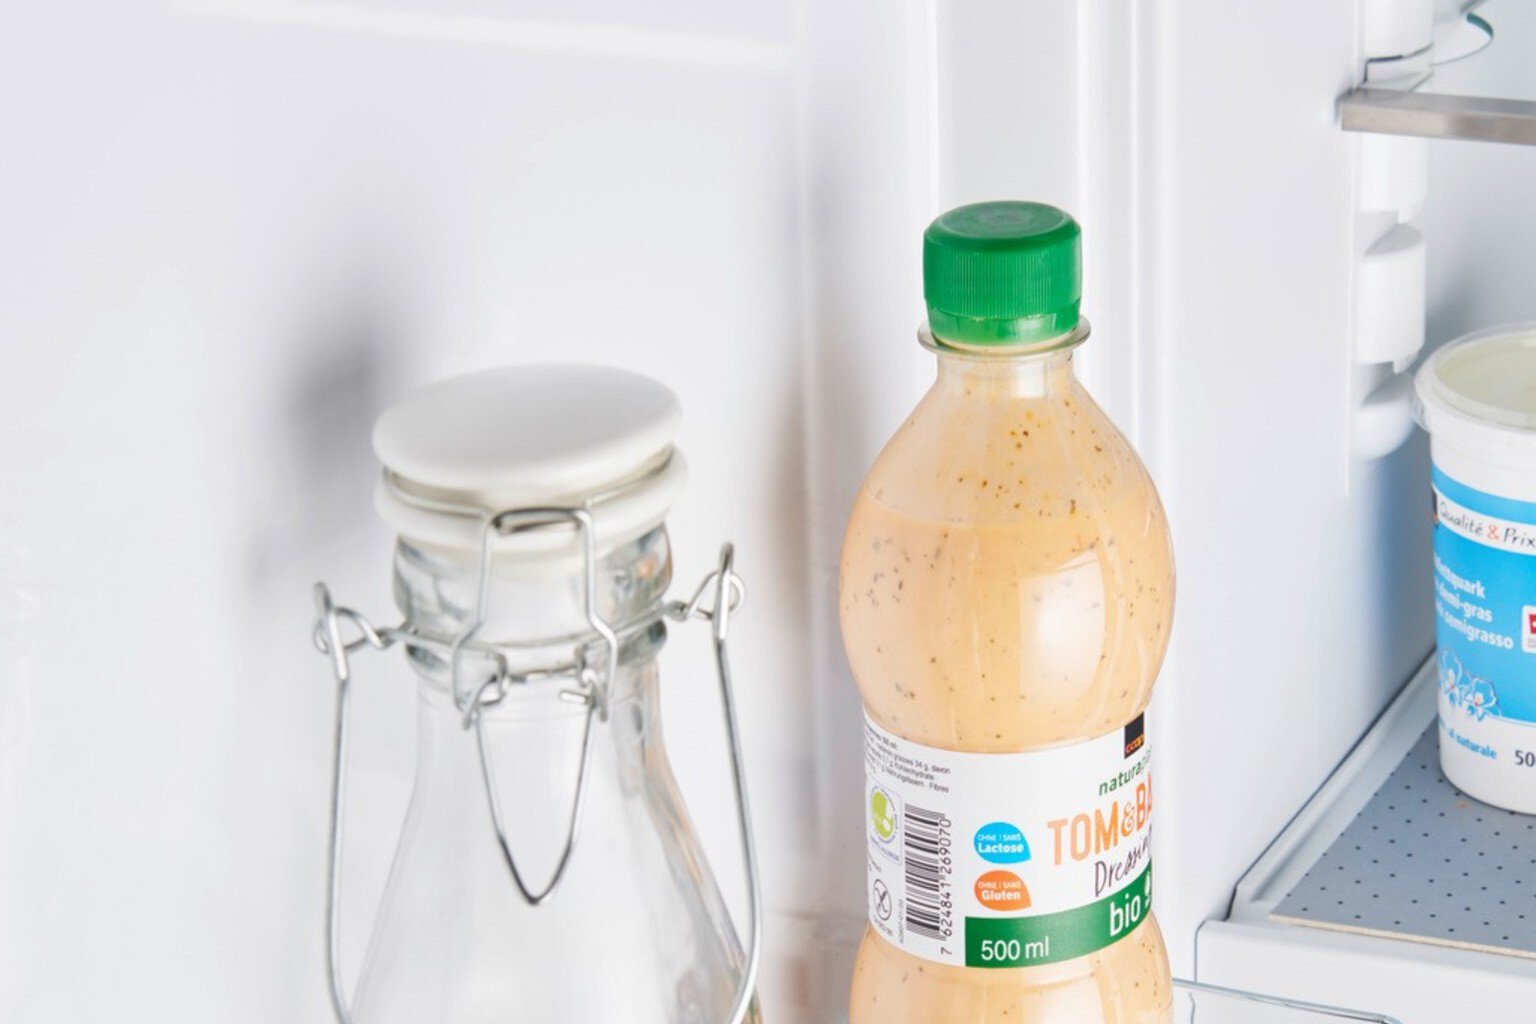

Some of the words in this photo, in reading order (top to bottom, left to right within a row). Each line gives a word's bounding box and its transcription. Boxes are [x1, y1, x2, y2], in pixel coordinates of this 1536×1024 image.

[1439, 501, 1483, 536] Qualité
[1487, 525, 1499, 540] &
[1504, 527, 1536, 548] Prix
[931, 765, 950, 774] davon
[939, 818, 952, 874] 269070
[978, 843, 1024, 853] Lactose
[982, 890, 1020, 900] Gluten
[940, 881, 952, 937] 624841
[1109, 893, 1141, 937] bio
[941, 947, 952, 955] 7
[980, 940, 1020, 961] 500
[1025, 937, 1049, 960] ml
